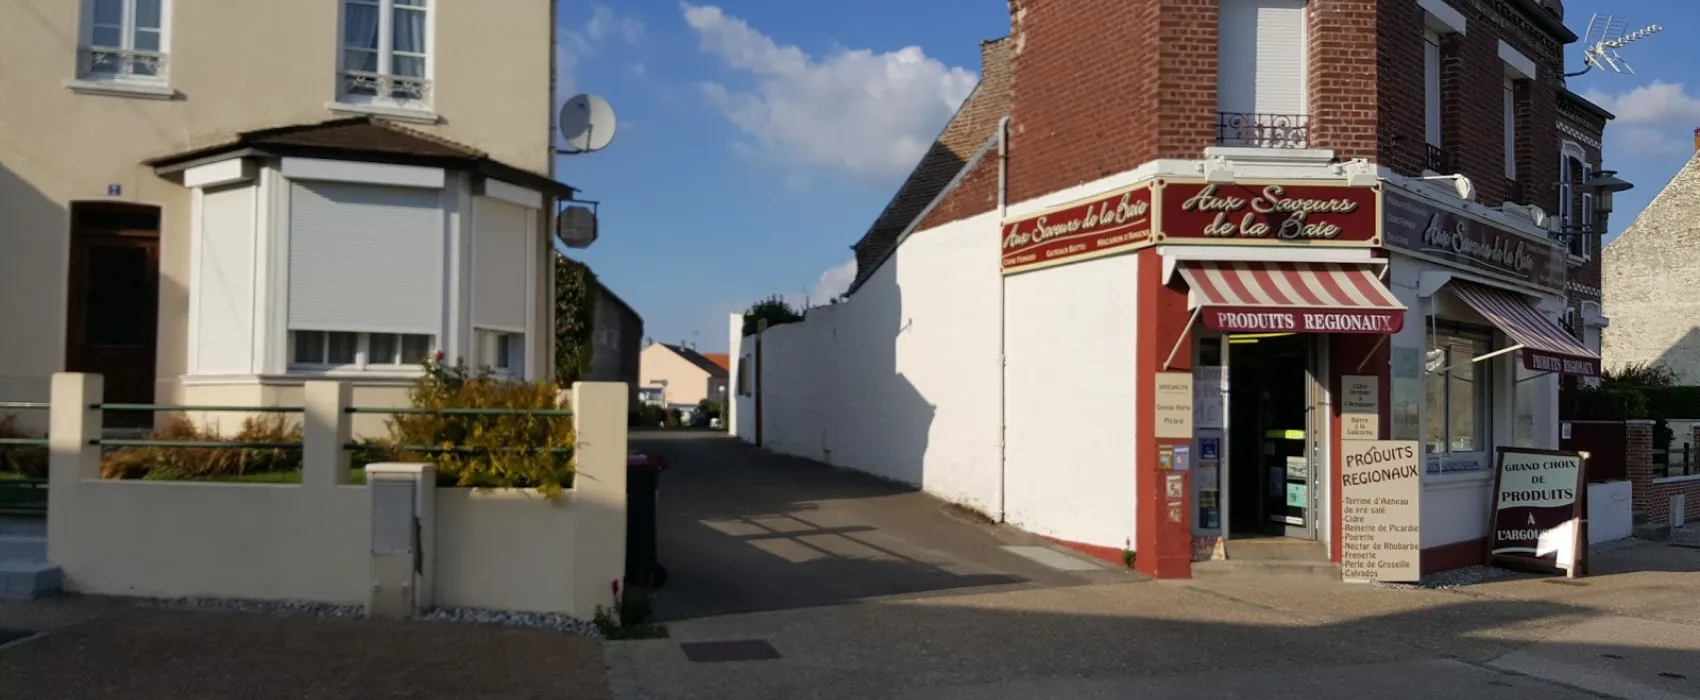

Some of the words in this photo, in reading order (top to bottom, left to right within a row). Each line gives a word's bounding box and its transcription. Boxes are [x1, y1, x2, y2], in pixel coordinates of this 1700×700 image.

[1181, 184, 1244, 211] Aux
[1251, 185, 1357, 213] Saveurs
[1003, 223, 1031, 248] Aux
[1032, 216, 1081, 242] Saveurs
[1082, 205, 1099, 229] de
[1100, 202, 1115, 225] la
[1115, 192, 1149, 223] Baie
[1203, 212, 1236, 236] de
[1240, 212, 1270, 236] la
[1278, 210, 1341, 239] Baie
[1424, 213, 1451, 248] Aux
[1217, 312, 1294, 329] PRODUITS
[1303, 313, 1393, 331] REGIONAUX
[1532, 354, 1560, 370] PRODUITS
[1563, 359, 1594, 374] REGIONAUX
[1505, 462, 1540, 472] GRAND
[1543, 460, 1577, 470] CHOIX
[1342, 465, 1418, 487] REGIONAUX
[1531, 475, 1545, 484] DE
[1502, 488, 1573, 502] PRODUITS
[1344, 506, 1353, 514] de
[1378, 524, 1387, 532] de
[1389, 524, 1418, 532] Picardie
[1372, 542, 1381, 550] de
[1383, 542, 1419, 550] Rhubarbe
[1366, 560, 1375, 568] de
